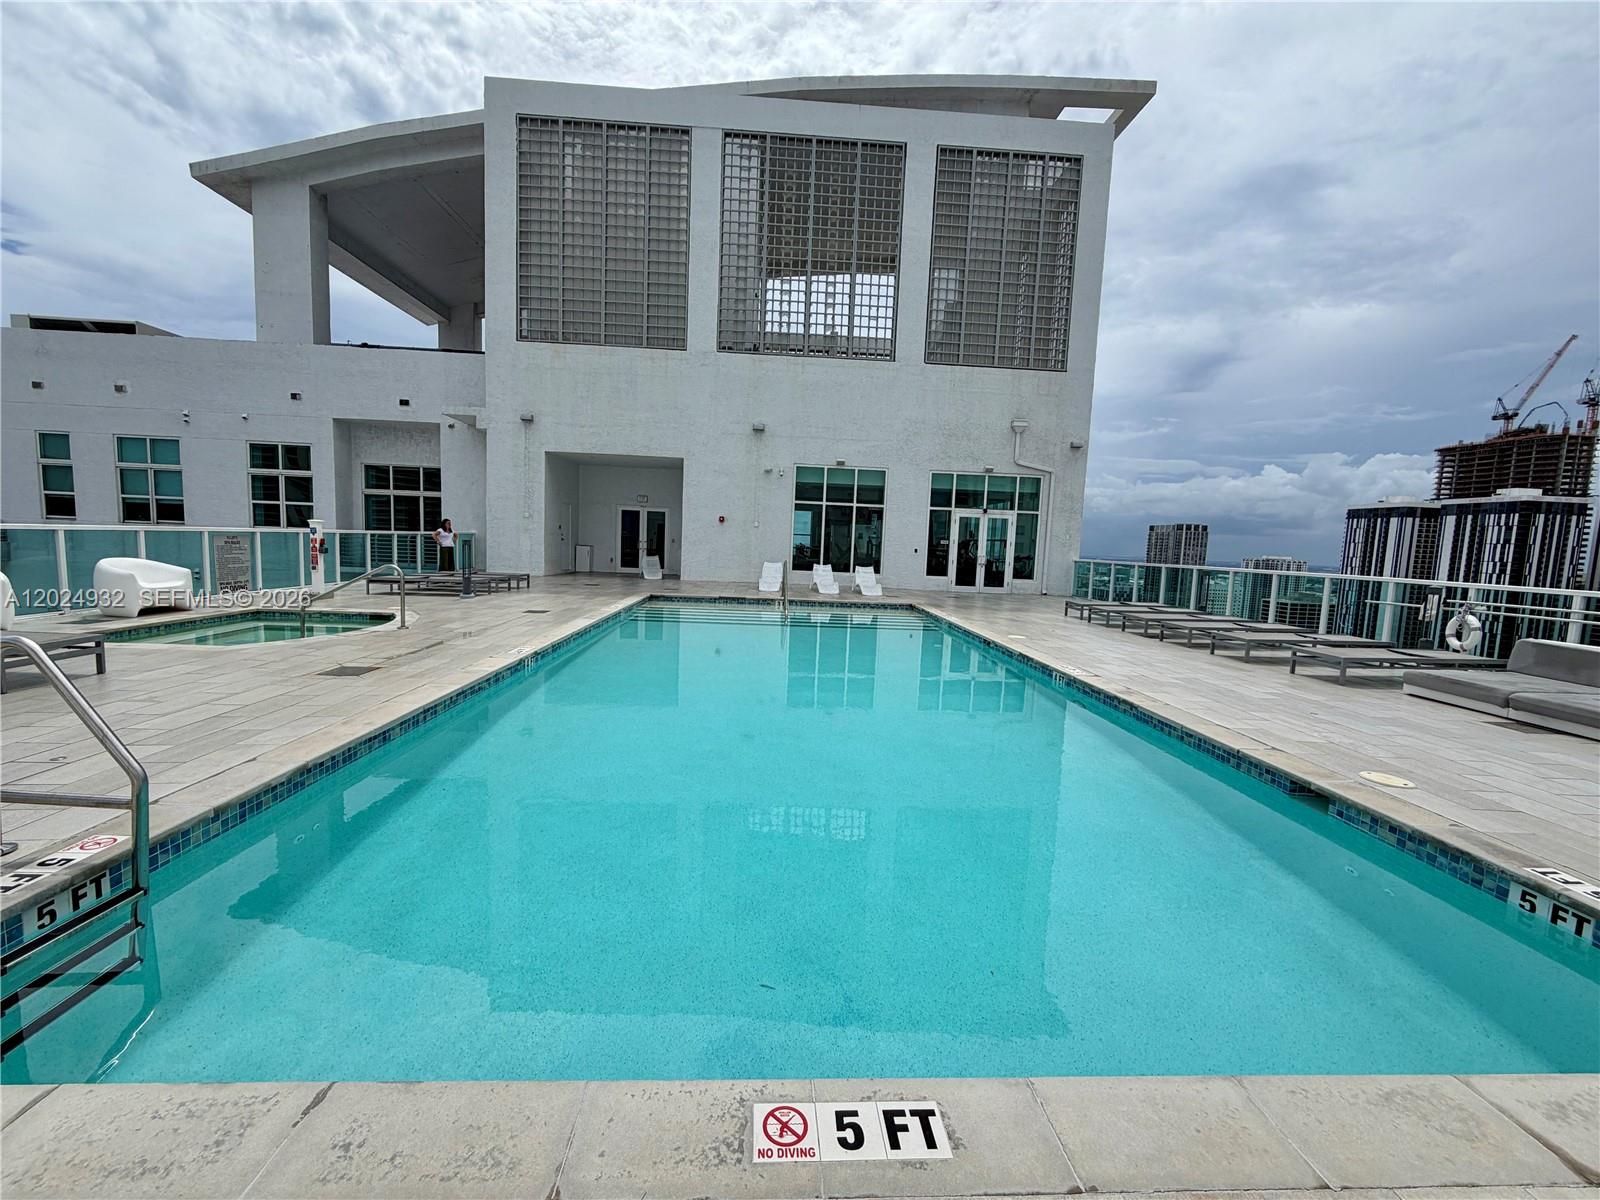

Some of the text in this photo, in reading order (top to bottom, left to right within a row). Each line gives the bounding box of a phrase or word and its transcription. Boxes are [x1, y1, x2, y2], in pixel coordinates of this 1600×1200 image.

[37, 871, 107, 930] 5 FT
[1518, 889, 1591, 938] 5 FT
[834, 1108, 938, 1151] 5 FT
[757, 1147, 816, 1159] NO DIVING
